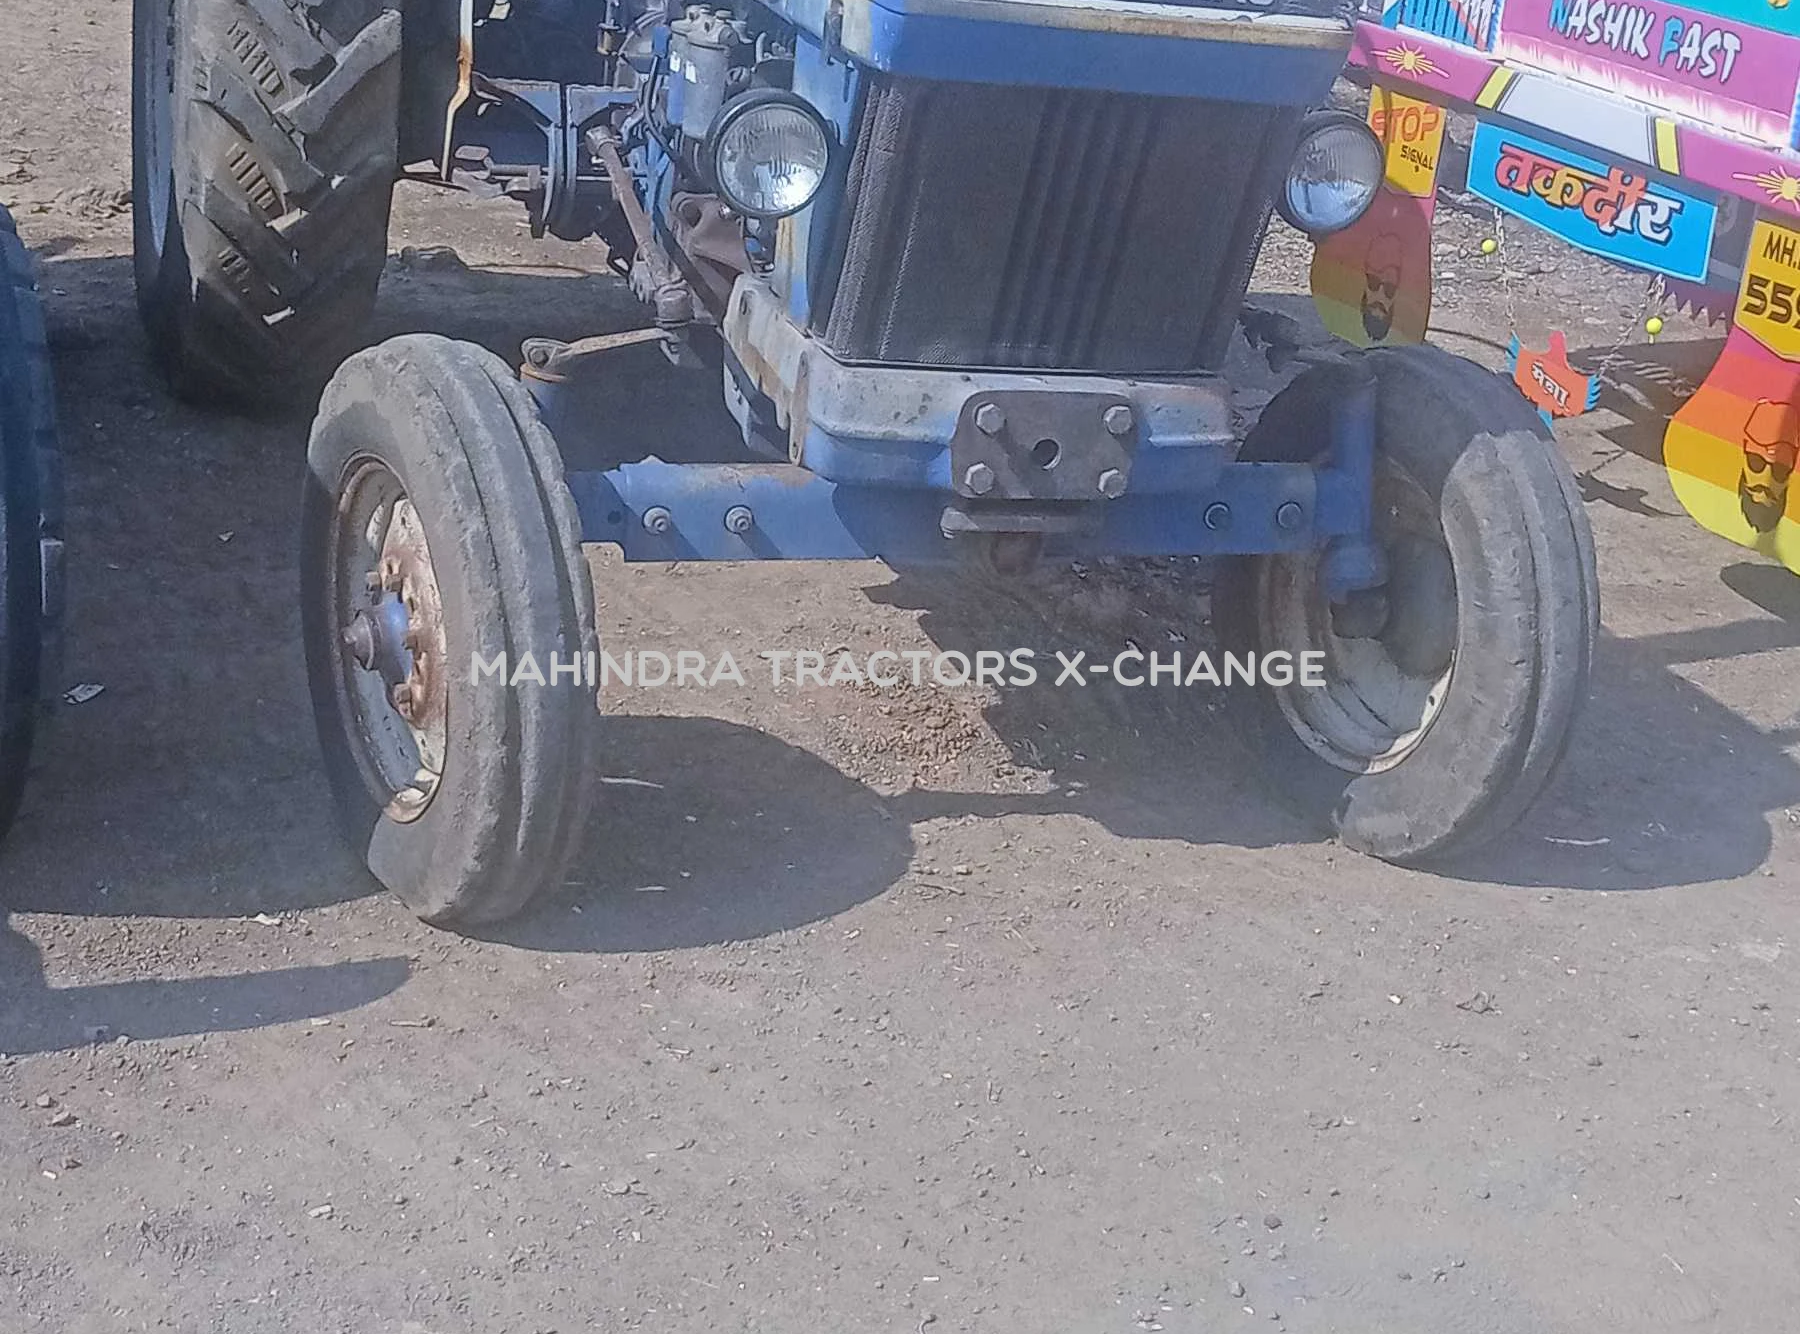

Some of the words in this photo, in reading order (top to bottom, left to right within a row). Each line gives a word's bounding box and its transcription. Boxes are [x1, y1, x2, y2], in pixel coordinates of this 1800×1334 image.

[1657, 16, 1743, 85] FAST
[1371, 105, 1440, 145] STOP
[1400, 144, 1434, 171] SIGNAL
[1495, 142, 1685, 247] तकदीर
